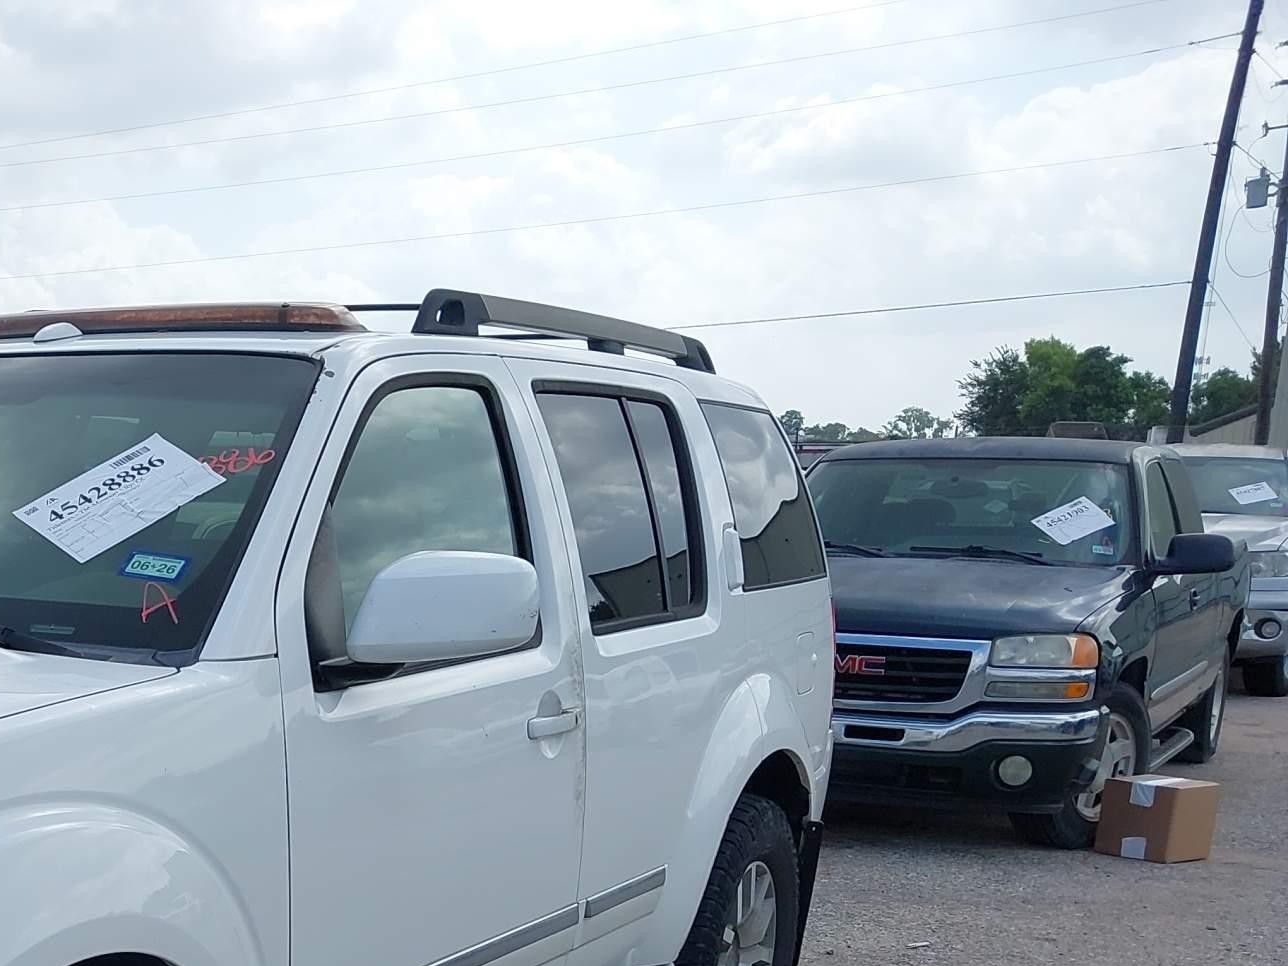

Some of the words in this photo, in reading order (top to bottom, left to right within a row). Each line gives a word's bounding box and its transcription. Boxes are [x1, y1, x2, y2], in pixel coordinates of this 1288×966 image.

[47, 454, 166, 524] 45428886
[141, 581, 179, 625] A
[834, 654, 886, 676] MC
